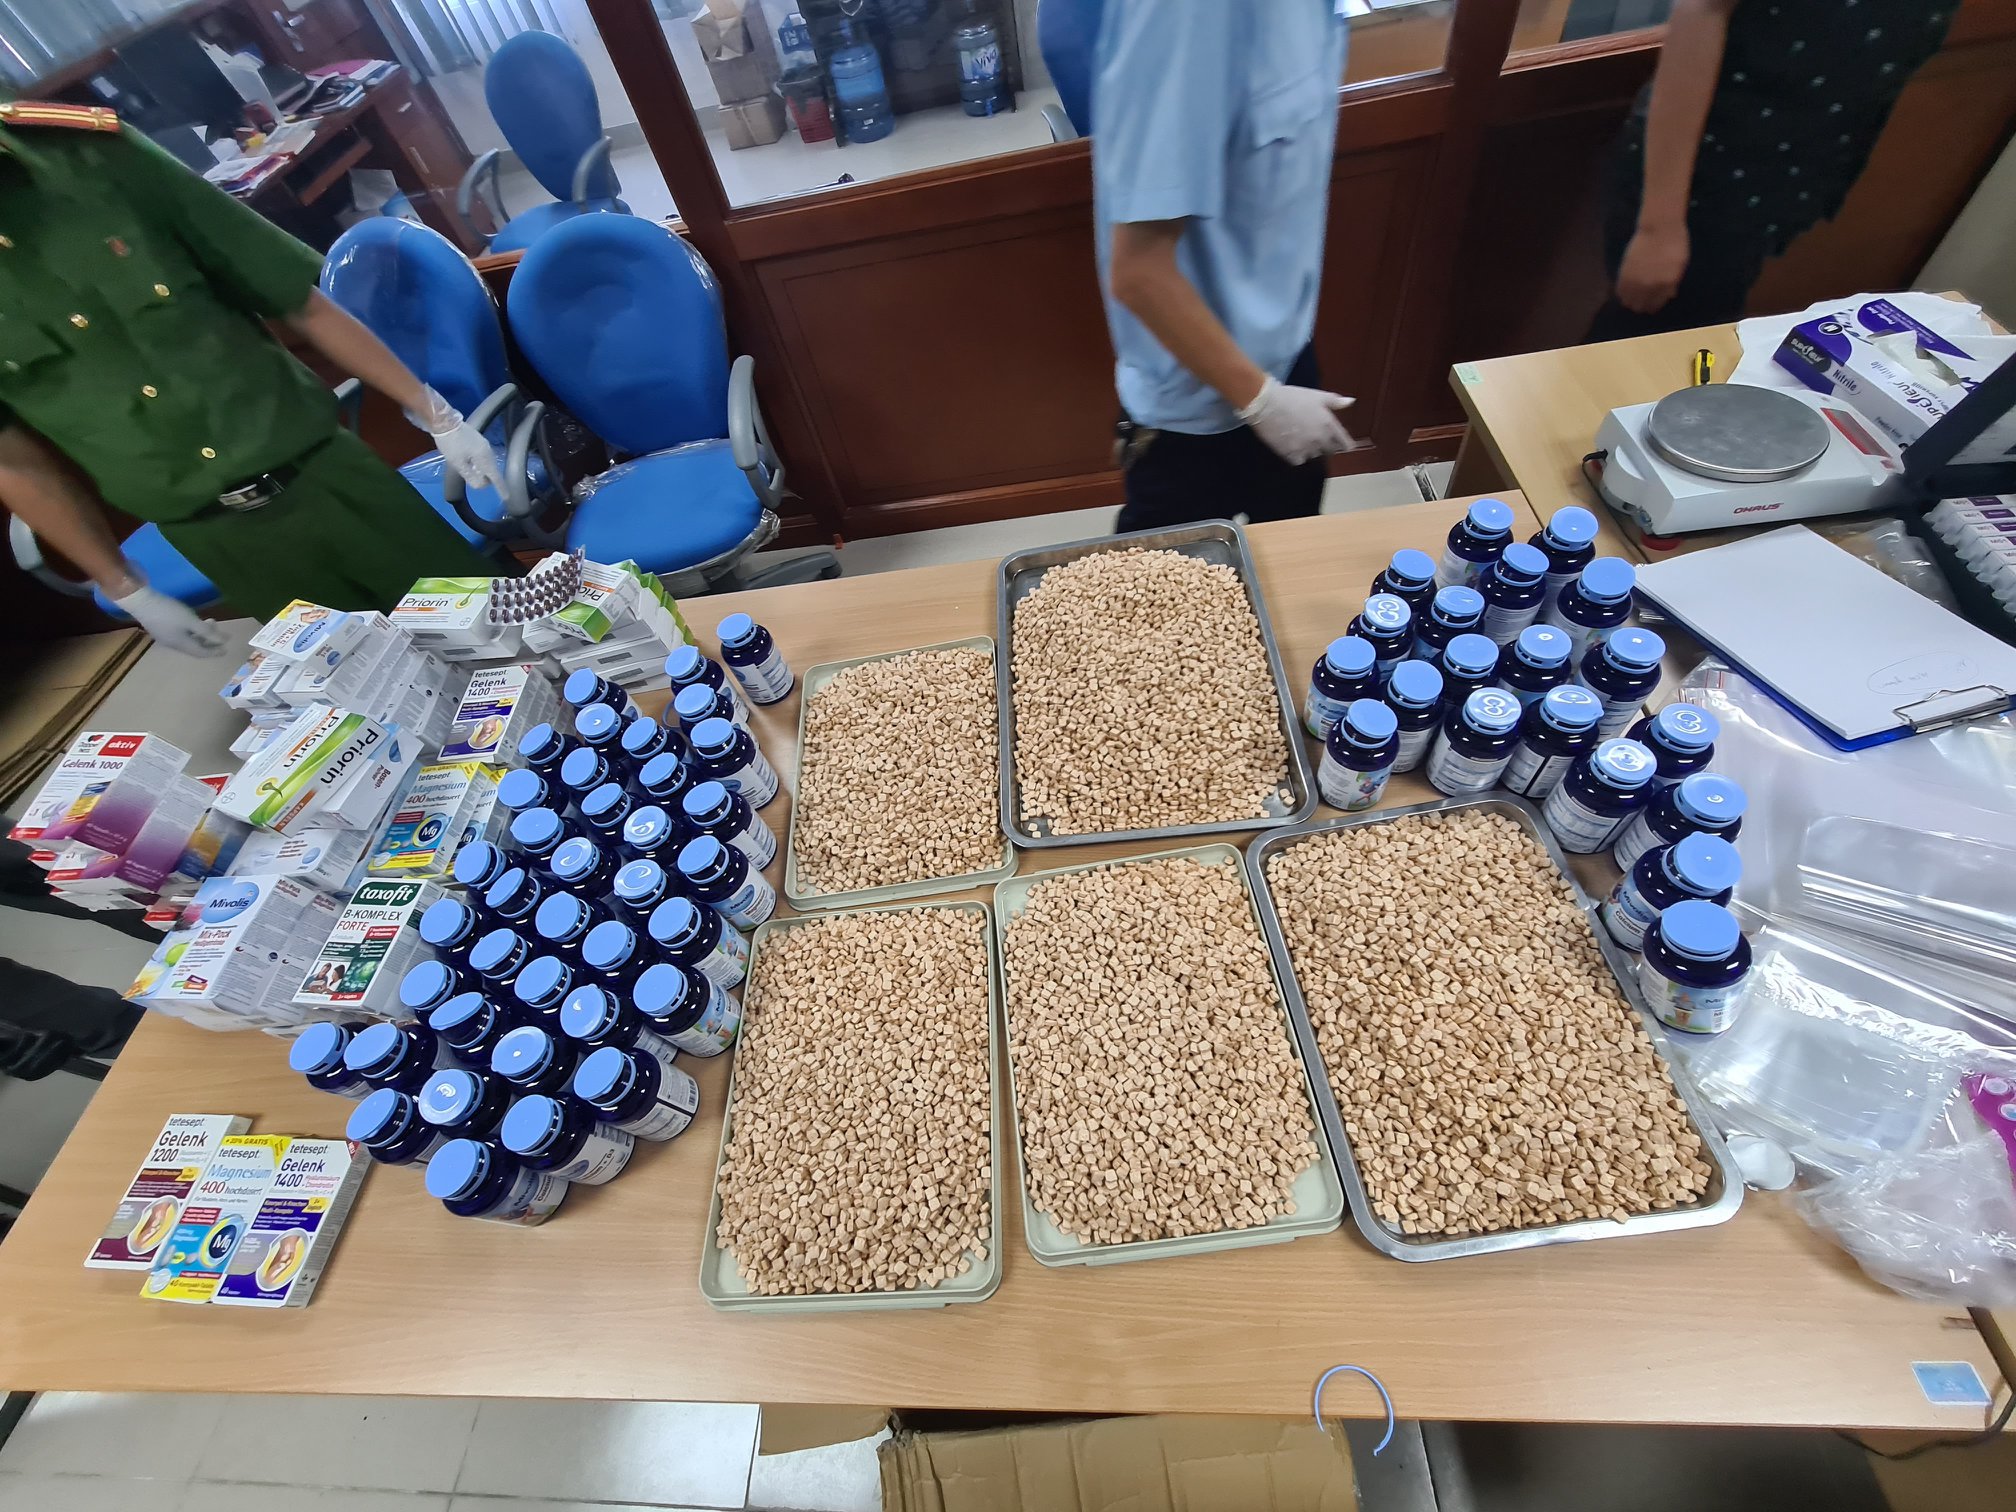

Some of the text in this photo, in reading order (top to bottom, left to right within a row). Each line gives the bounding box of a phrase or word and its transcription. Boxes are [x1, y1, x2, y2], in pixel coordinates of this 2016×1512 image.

[1832, 369, 1858, 392] Nitrile
[1733, 503, 1783, 514] OHAUS
[402, 597, 449, 607] Priorin
[474, 669, 507, 678] tetesept
[470, 678, 507, 688] Gelenk
[467, 688, 491, 697] 1400
[108, 741, 136, 749] aktiv
[283, 716, 340, 768] Priorin
[320, 728, 380, 785] Priorin
[62, 759, 97, 769] Gelenk
[99, 761, 124, 770] 1000
[418, 772, 451, 782] tetesept
[412, 782, 467, 795] Magnesium
[406, 794, 427, 805] 400
[421, 826, 438, 837] Mg
[359, 884, 414, 901] taxofit
[209, 899, 250, 909] Mivolis
[343, 909, 403, 921] B-KOMPLEX
[337, 921, 369, 932] FORTE
[1615, 910, 1641, 934] Calcium
[169, 1117, 205, 1127] tetesept
[158, 1131, 208, 1148] Gelenk
[219, 1148, 259, 1159] tetesept
[290, 1144, 328, 1155] tetesept
[150, 1149, 179, 1163] 1200
[281, 1158, 326, 1173] Gelenk
[207, 1164, 273, 1181] Magnesium
[274, 1173, 303, 1188] 1400
[200, 1181, 225, 1194] 400
[212, 1234, 232, 1253] Mg
